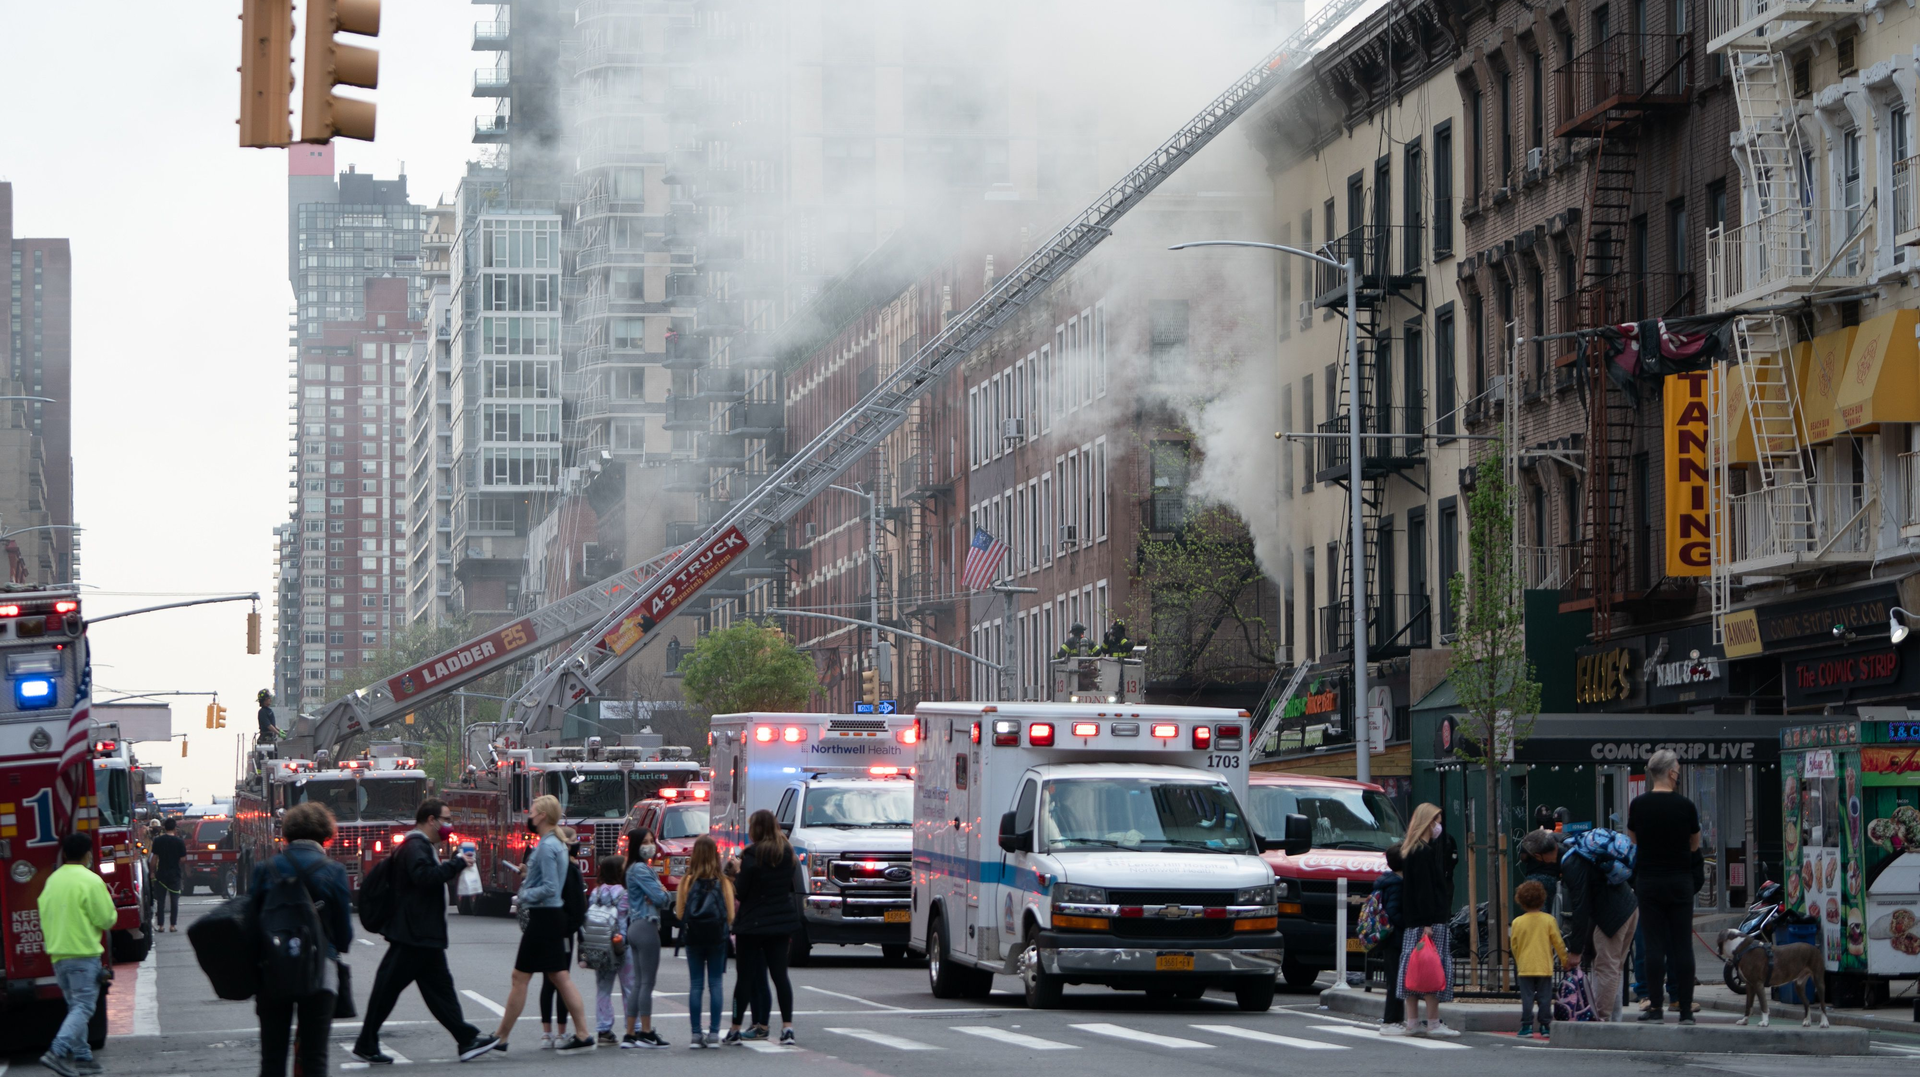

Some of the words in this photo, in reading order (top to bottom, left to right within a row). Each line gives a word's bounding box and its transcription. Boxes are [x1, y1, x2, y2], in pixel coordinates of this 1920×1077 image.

[1810, 420, 1822, 431] BEACH
[1812, 429, 1828, 440] TANNING
[1676, 373, 1709, 566] TANNING
[652, 584, 677, 616] 43
[676, 532, 743, 582] TRUCK
[670, 577, 704, 607] Spanish
[703, 554, 732, 579] Harlem
[1724, 618, 1757, 648] TANNING
[422, 640, 496, 684] LADDER
[501, 624, 527, 650] 25
[1656, 660, 1683, 688] NAIL
[1796, 663, 1815, 688] The
[1818, 658, 1856, 687] COMIC
[1859, 651, 1897, 681] STRIP
[1126, 680, 1137, 693] 13
[811, 744, 865, 755] Northwell
[868, 745, 902, 755] Health
[1207, 755, 1240, 769] 1703
[584, 771, 622, 781] panish
[22, 787, 59, 848] 1
[12, 910, 40, 922] KEE
[12, 921, 41, 933] BAC
[20, 932, 43, 944] 200
